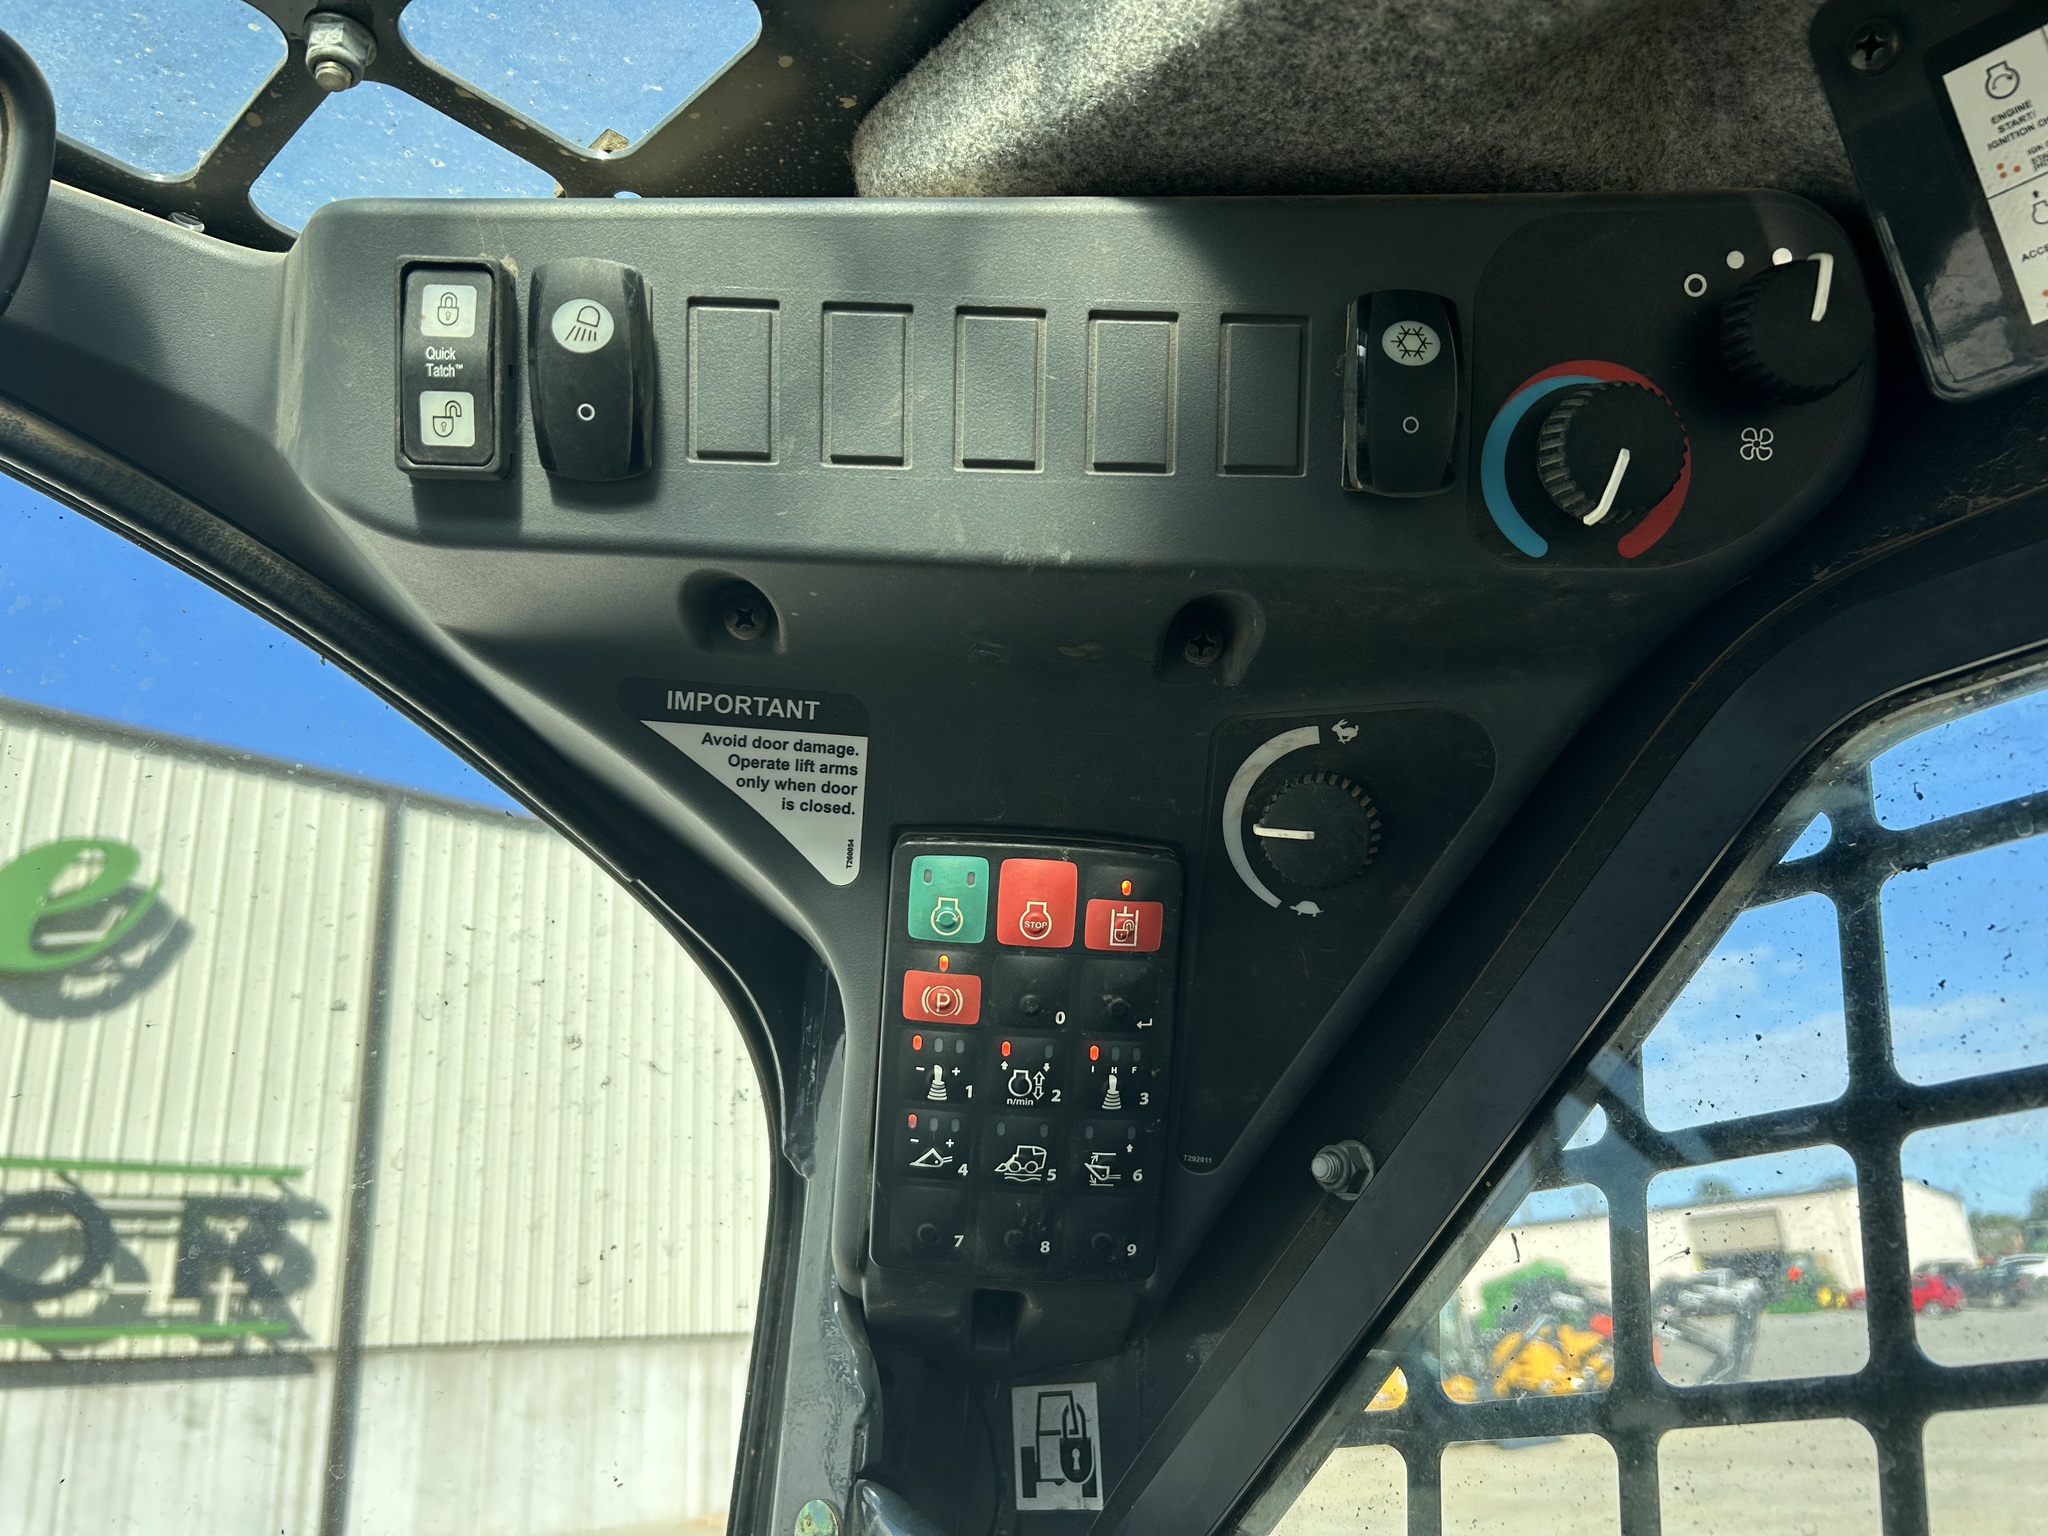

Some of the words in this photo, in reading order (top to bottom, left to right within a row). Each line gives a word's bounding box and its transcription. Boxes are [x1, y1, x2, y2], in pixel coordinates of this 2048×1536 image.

[1991, 99, 2033, 124] ENGINE
[1998, 109, 2036, 134] START/
[1987, 122, 2036, 151] IGNITION
[425, 346, 456, 360] Quick
[667, 690, 820, 720] IMPORTANT
[701, 732, 747, 748] Avoid
[752, 735, 789, 750] door
[793, 738, 859, 758] damage.
[728, 754, 790, 770] Operate
[795, 758, 815, 773] lift
[819, 762, 858, 775] arms
[736, 776, 770, 792] only
[775, 778, 816, 793] when
[821, 780, 857, 795] door
[782, 798, 795, 811] is
[800, 799, 855, 815] closed.
[1024, 920, 1048, 929] STOP
[936, 992, 951, 1012] P
[1055, 1011, 1066, 1025] 0
[1111, 1066, 1118, 1074] H
[1131, 1066, 1138, 1074] F
[965, 1085, 973, 1098] 1
[1051, 1089, 1062, 1102] 2
[1006, 1097, 1034, 1106] n/min
[1139, 1092, 1149, 1105] 3
[957, 1163, 969, 1176] 4
[1046, 1168, 1057, 1181] 5
[1132, 1169, 1143, 1182] 6
[954, 1235, 964, 1247] 7
[1040, 1241, 1050, 1253] 8
[1127, 1244, 1137, 1256] 9
